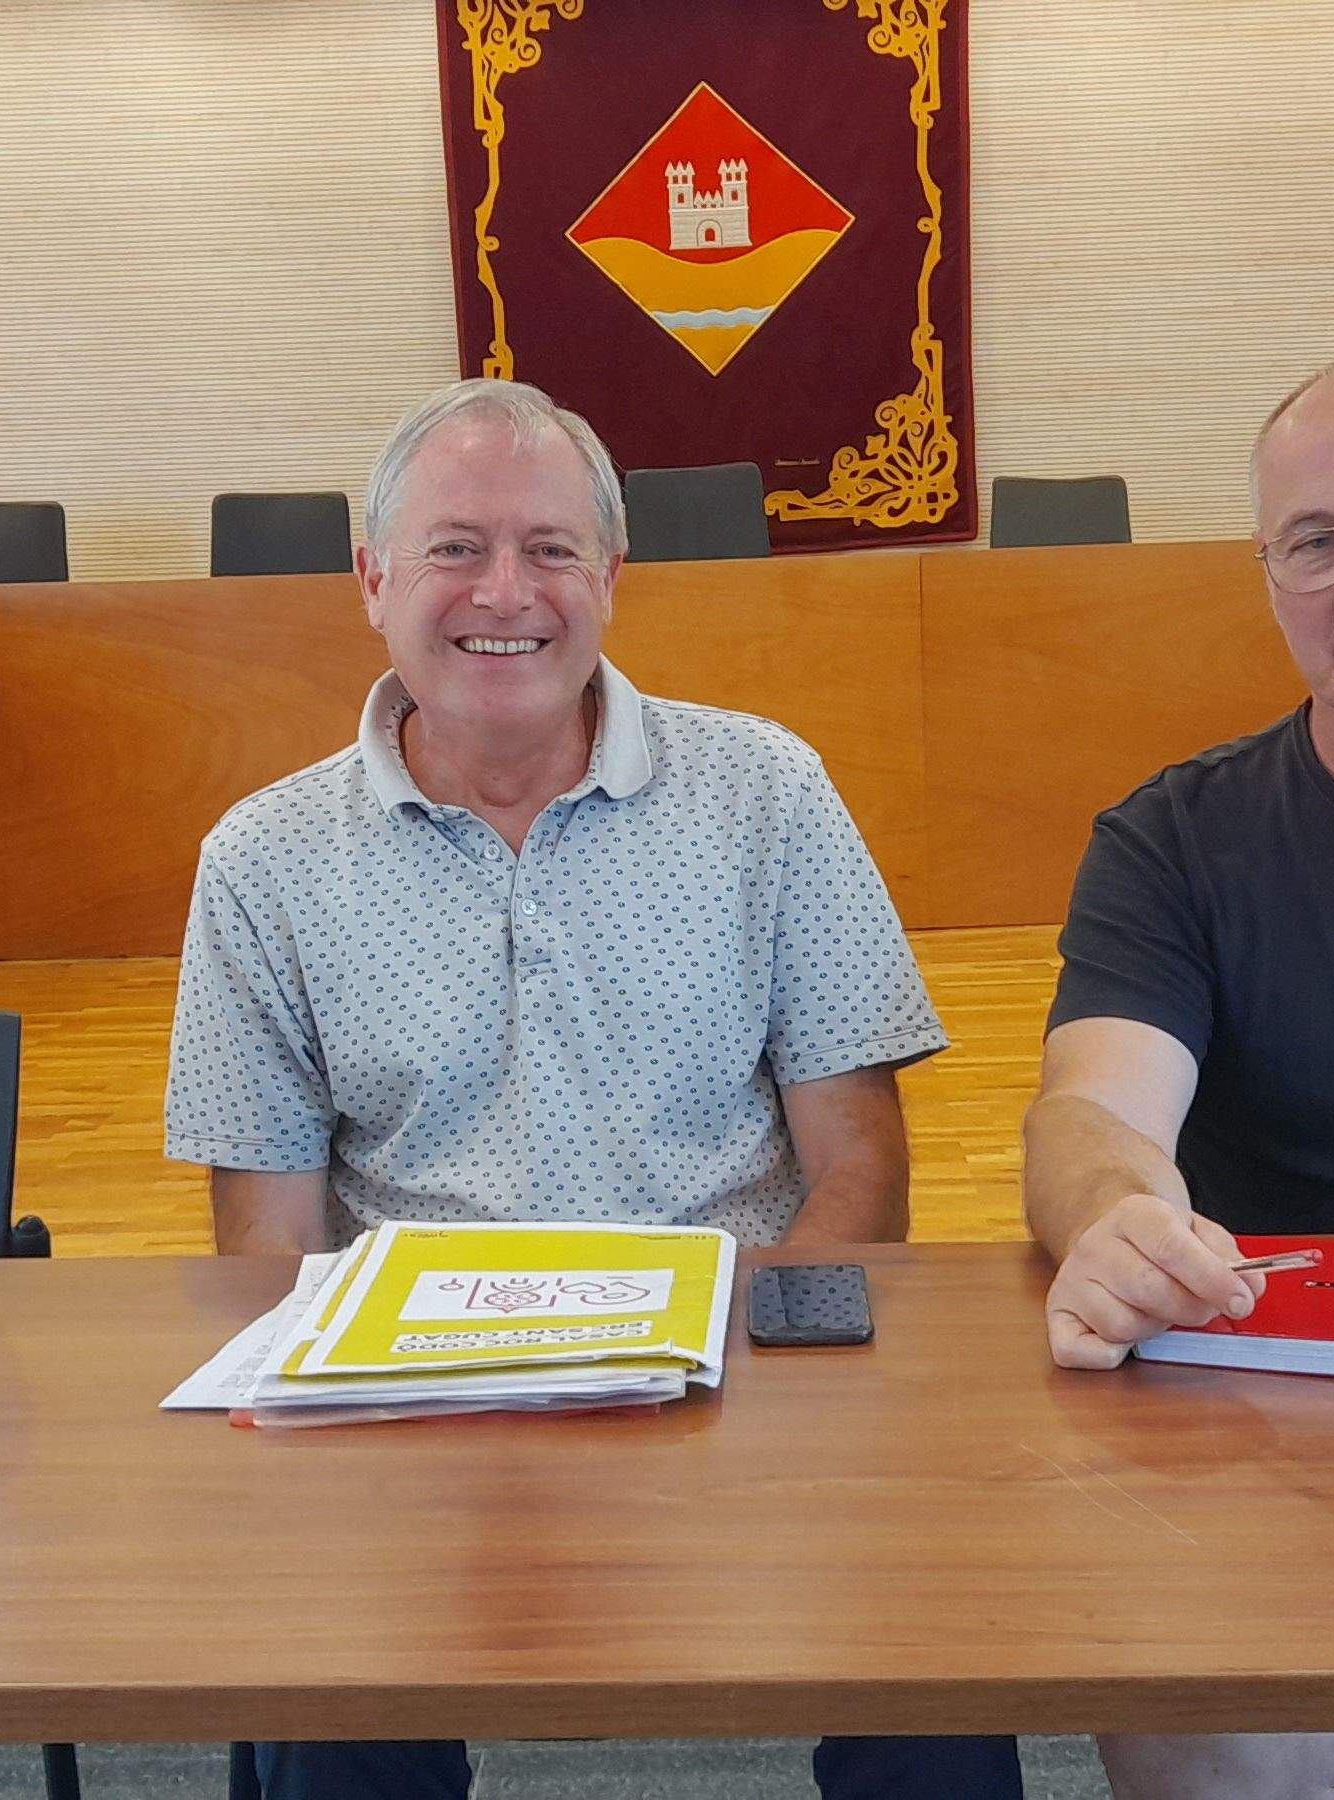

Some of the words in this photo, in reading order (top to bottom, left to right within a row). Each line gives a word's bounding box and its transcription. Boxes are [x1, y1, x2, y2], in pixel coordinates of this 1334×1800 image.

[512, 1327, 585, 1336] SANT
[558, 1329, 643, 1342] CASAL
[403, 1332, 499, 1342] CUGAT
[484, 1337, 542, 1345] ROC
